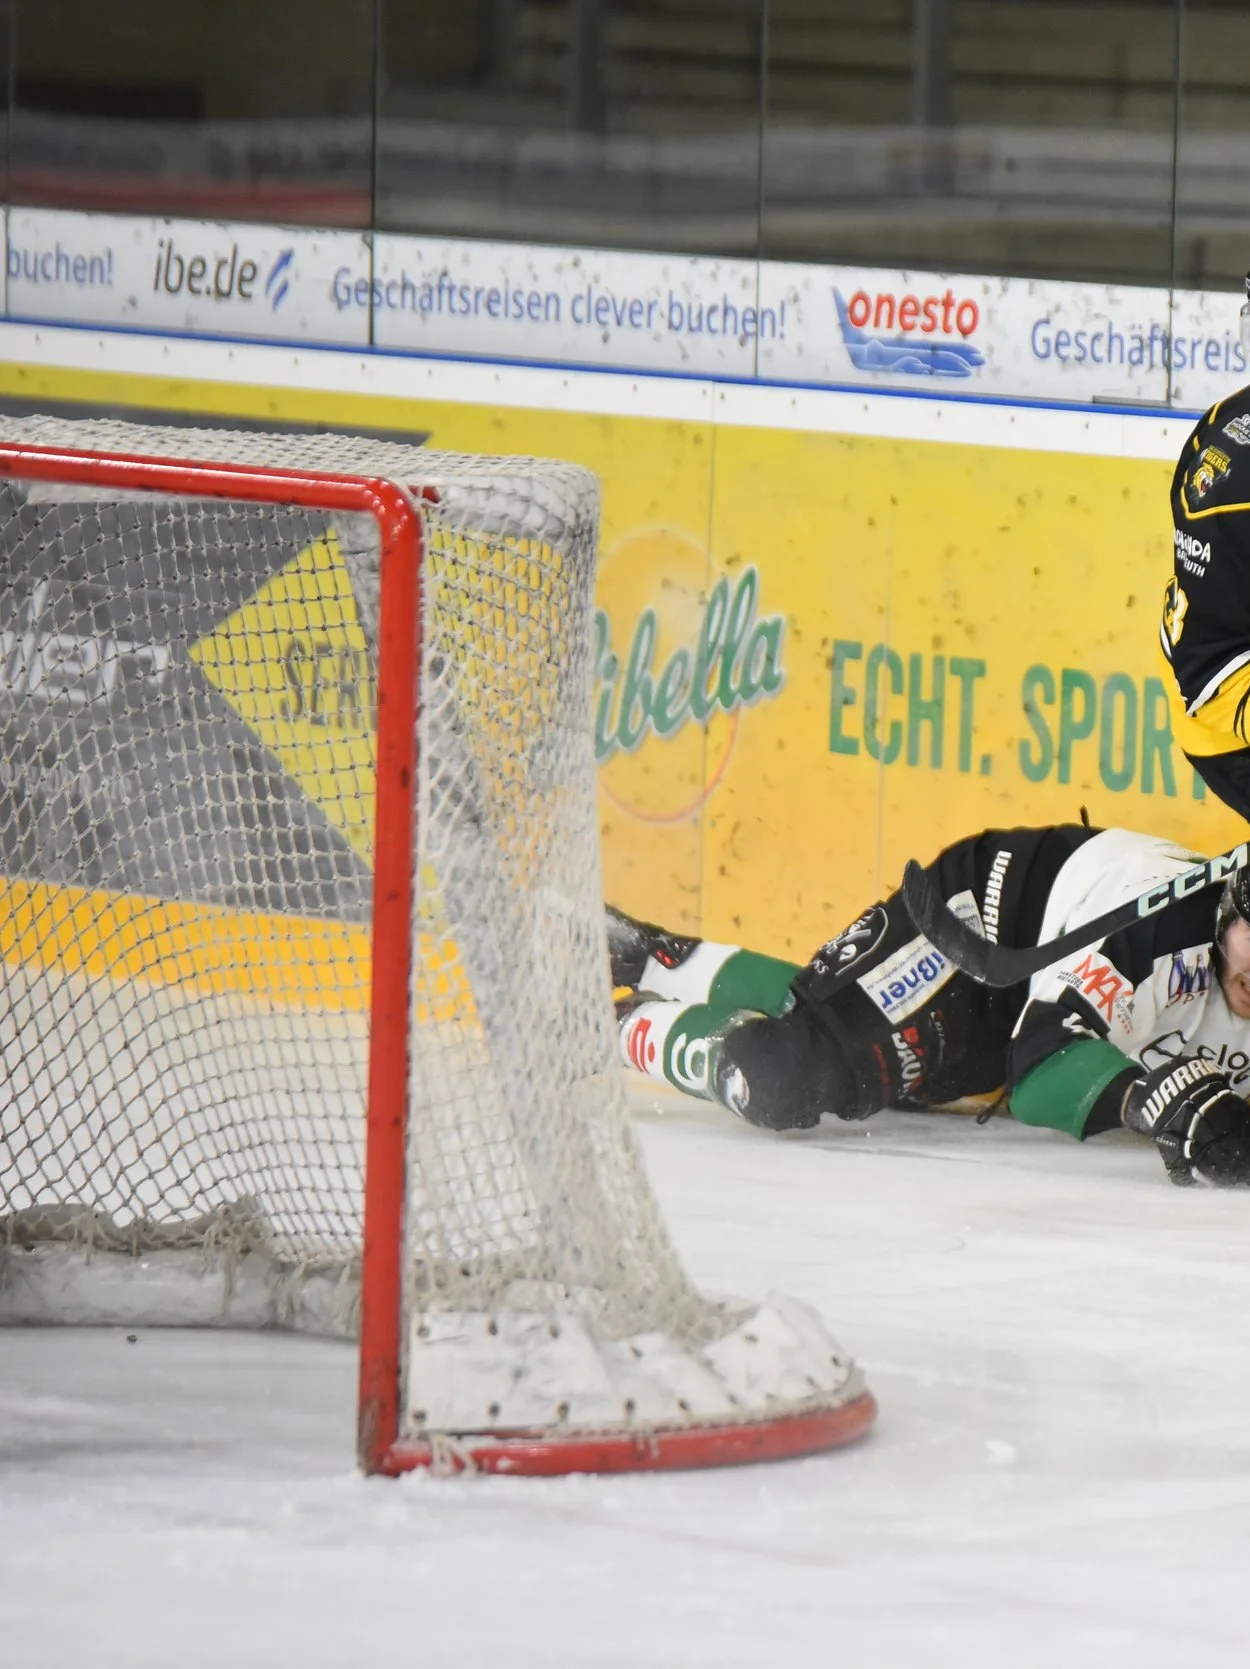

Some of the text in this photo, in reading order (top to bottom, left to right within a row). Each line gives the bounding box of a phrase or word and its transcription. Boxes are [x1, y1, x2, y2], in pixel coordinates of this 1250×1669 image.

[6, 242, 113, 285] buchen!
[153, 238, 258, 301] ibe.de
[332, 267, 787, 341] Geschäftsreisen clever buchen!
[848, 289, 980, 337] onesto
[828, 639, 993, 777] ECHT.
[1019, 662, 1207, 801] SPOR
[1137, 843, 1248, 918] CCM
